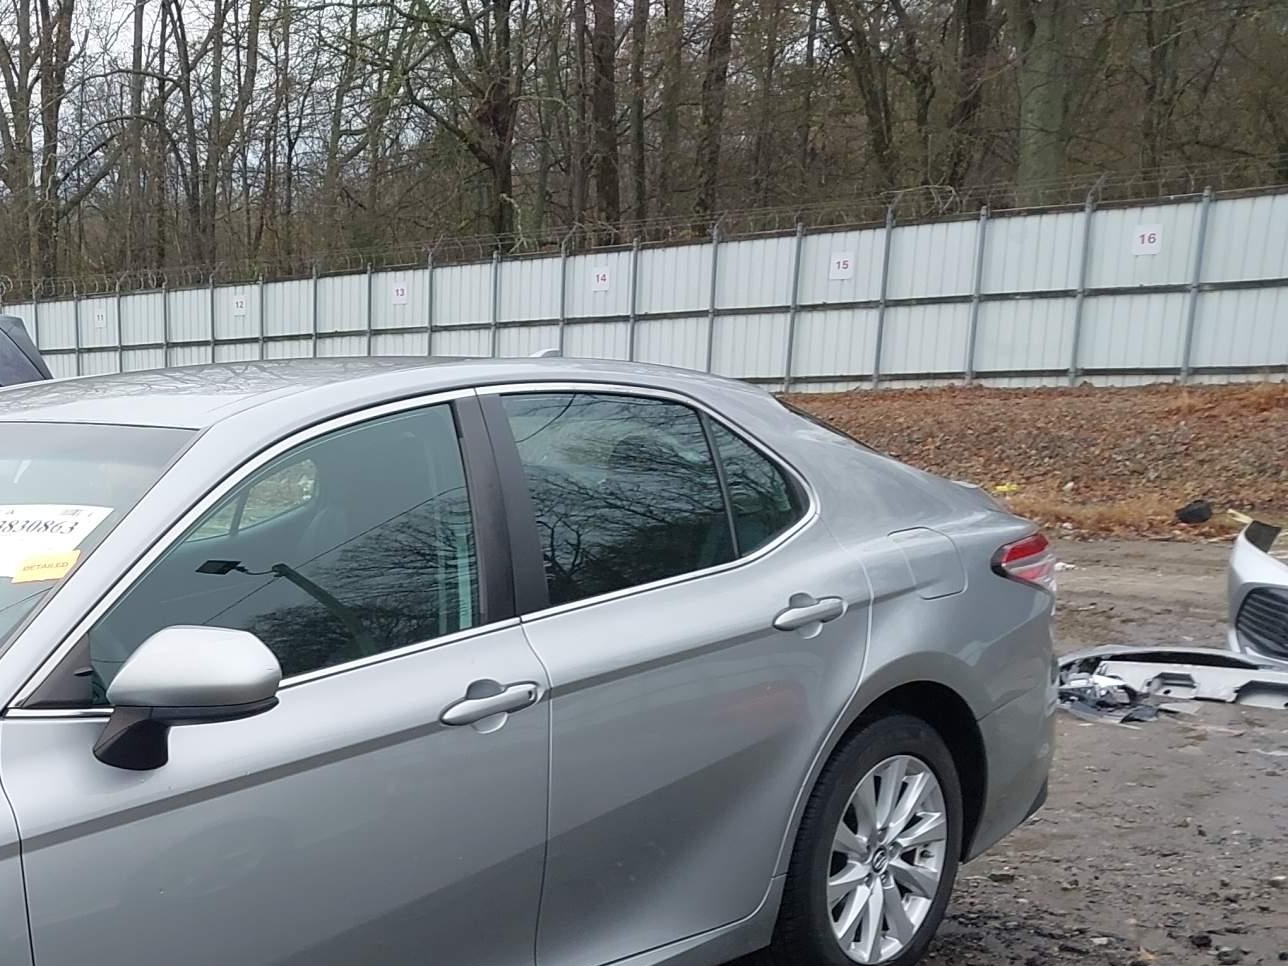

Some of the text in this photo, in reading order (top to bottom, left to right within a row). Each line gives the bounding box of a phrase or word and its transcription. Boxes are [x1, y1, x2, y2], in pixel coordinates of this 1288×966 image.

[1139, 233, 1156, 244] 16
[836, 260, 849, 270] 15
[595, 273, 607, 283] 14
[395, 288, 405, 297] 13
[235, 301, 244, 309] 12
